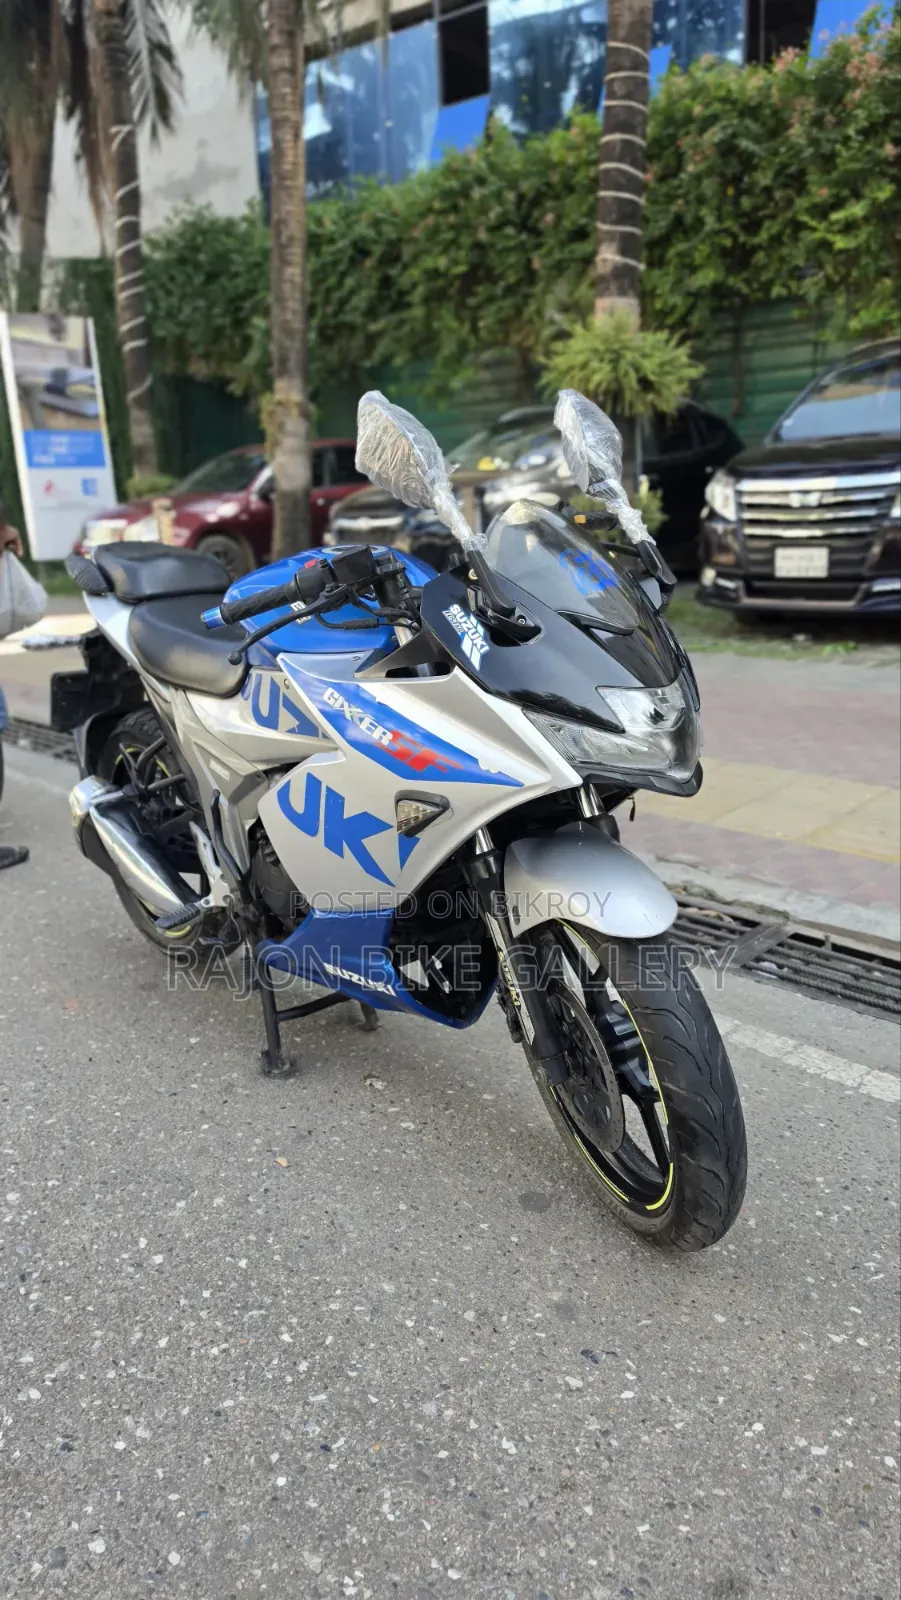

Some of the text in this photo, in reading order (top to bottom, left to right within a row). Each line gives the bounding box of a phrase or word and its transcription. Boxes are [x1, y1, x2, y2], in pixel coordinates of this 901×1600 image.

[449, 603, 491, 654] SUZUKI
[322, 686, 464, 773] GIXXER SF
[323, 962, 398, 997] SUZUKI
[497, 950, 521, 1007] SUZUKI
